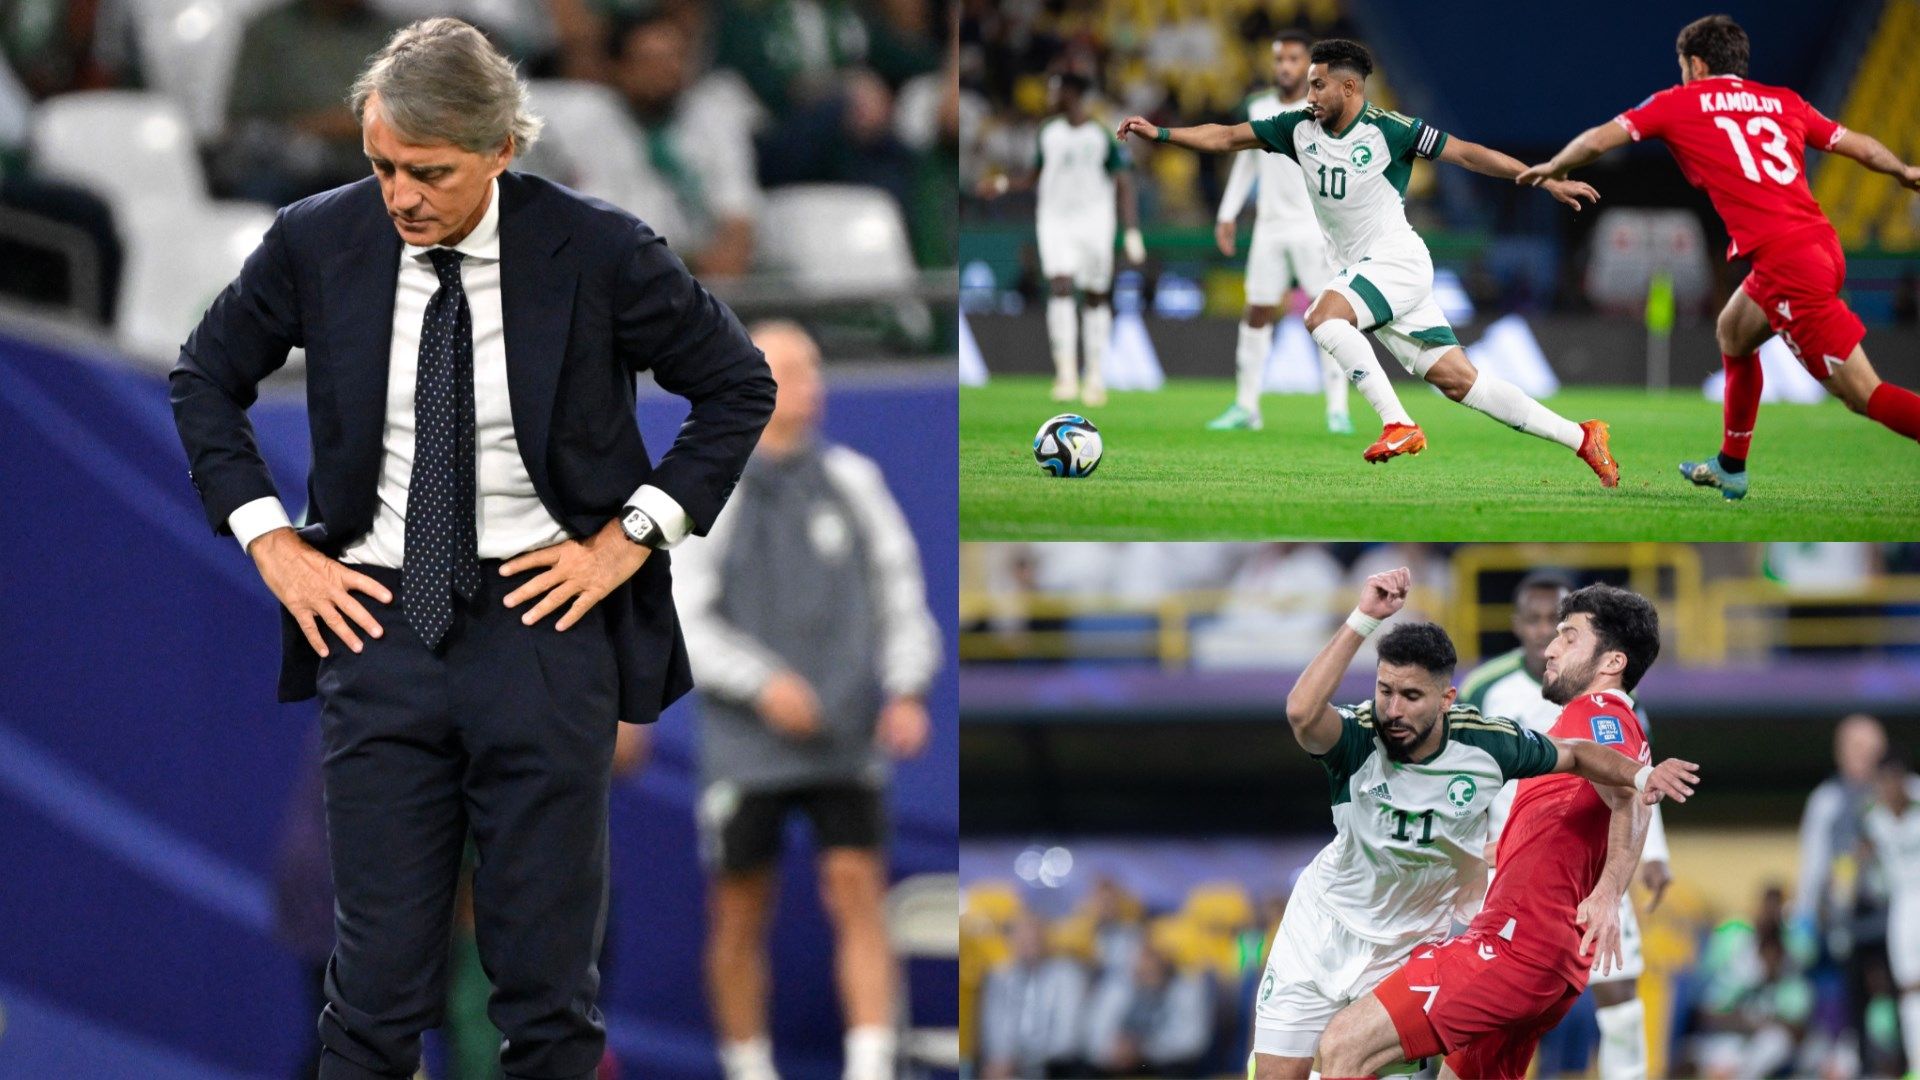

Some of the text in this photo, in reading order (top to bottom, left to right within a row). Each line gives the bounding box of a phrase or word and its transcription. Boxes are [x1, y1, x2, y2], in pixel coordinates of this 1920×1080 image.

[1713, 116, 1798, 186] 13
[1317, 164, 1347, 200] 10
[1391, 808, 1435, 844] 11
